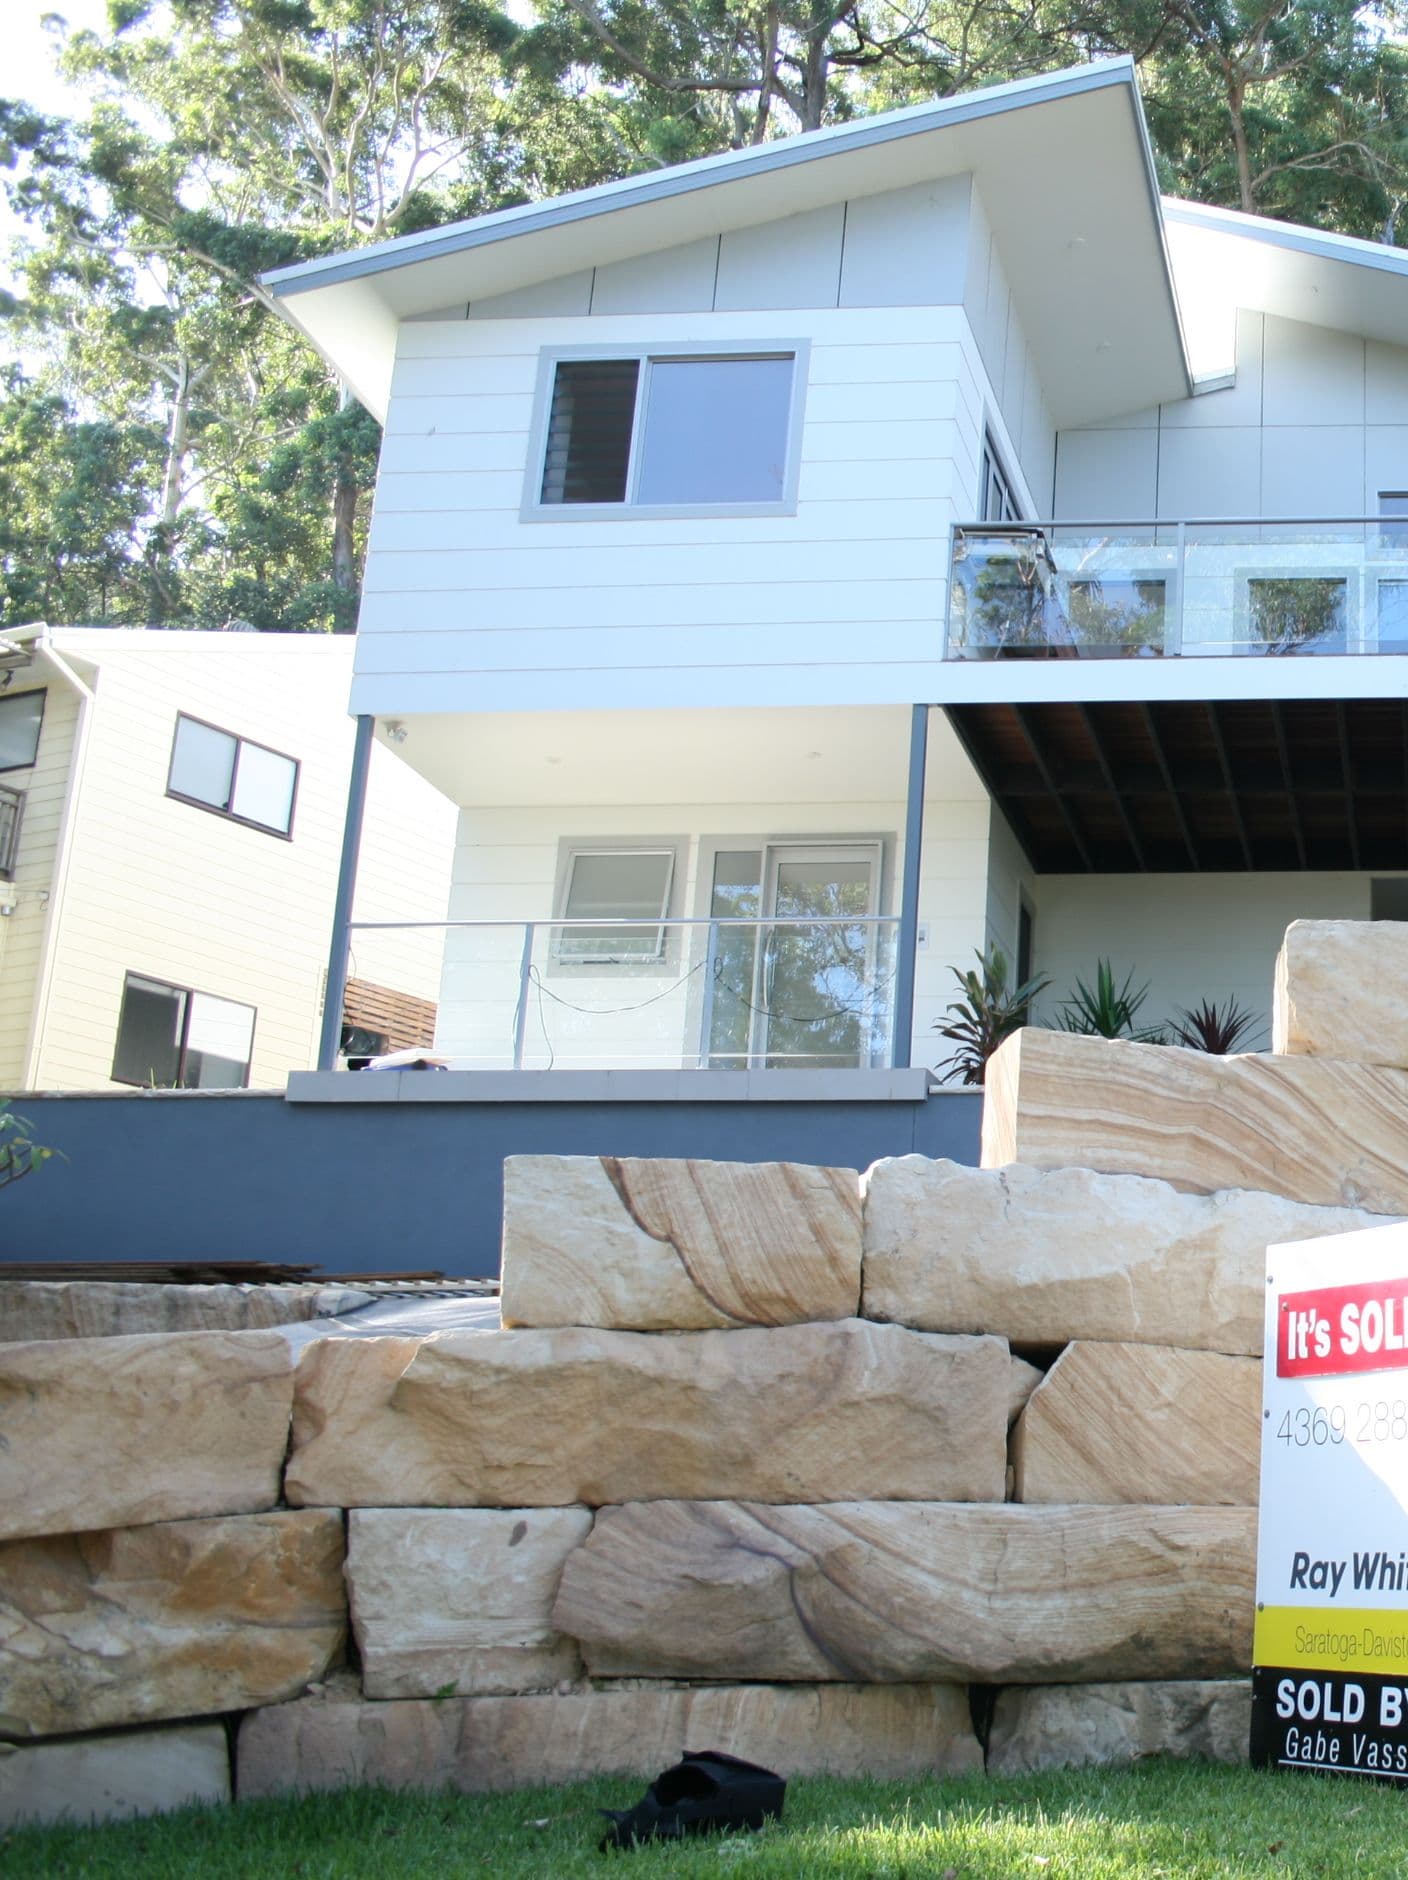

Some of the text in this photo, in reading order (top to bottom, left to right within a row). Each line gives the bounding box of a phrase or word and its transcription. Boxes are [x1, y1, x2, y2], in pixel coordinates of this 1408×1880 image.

[1288, 1308, 1331, 1360] It's
[1277, 1406, 1346, 1447] 4369
[1290, 1552, 1346, 1597] Ray
[1276, 1678, 1365, 1724] SOLD
[1285, 1726, 1408, 1770] Gabe Vass
